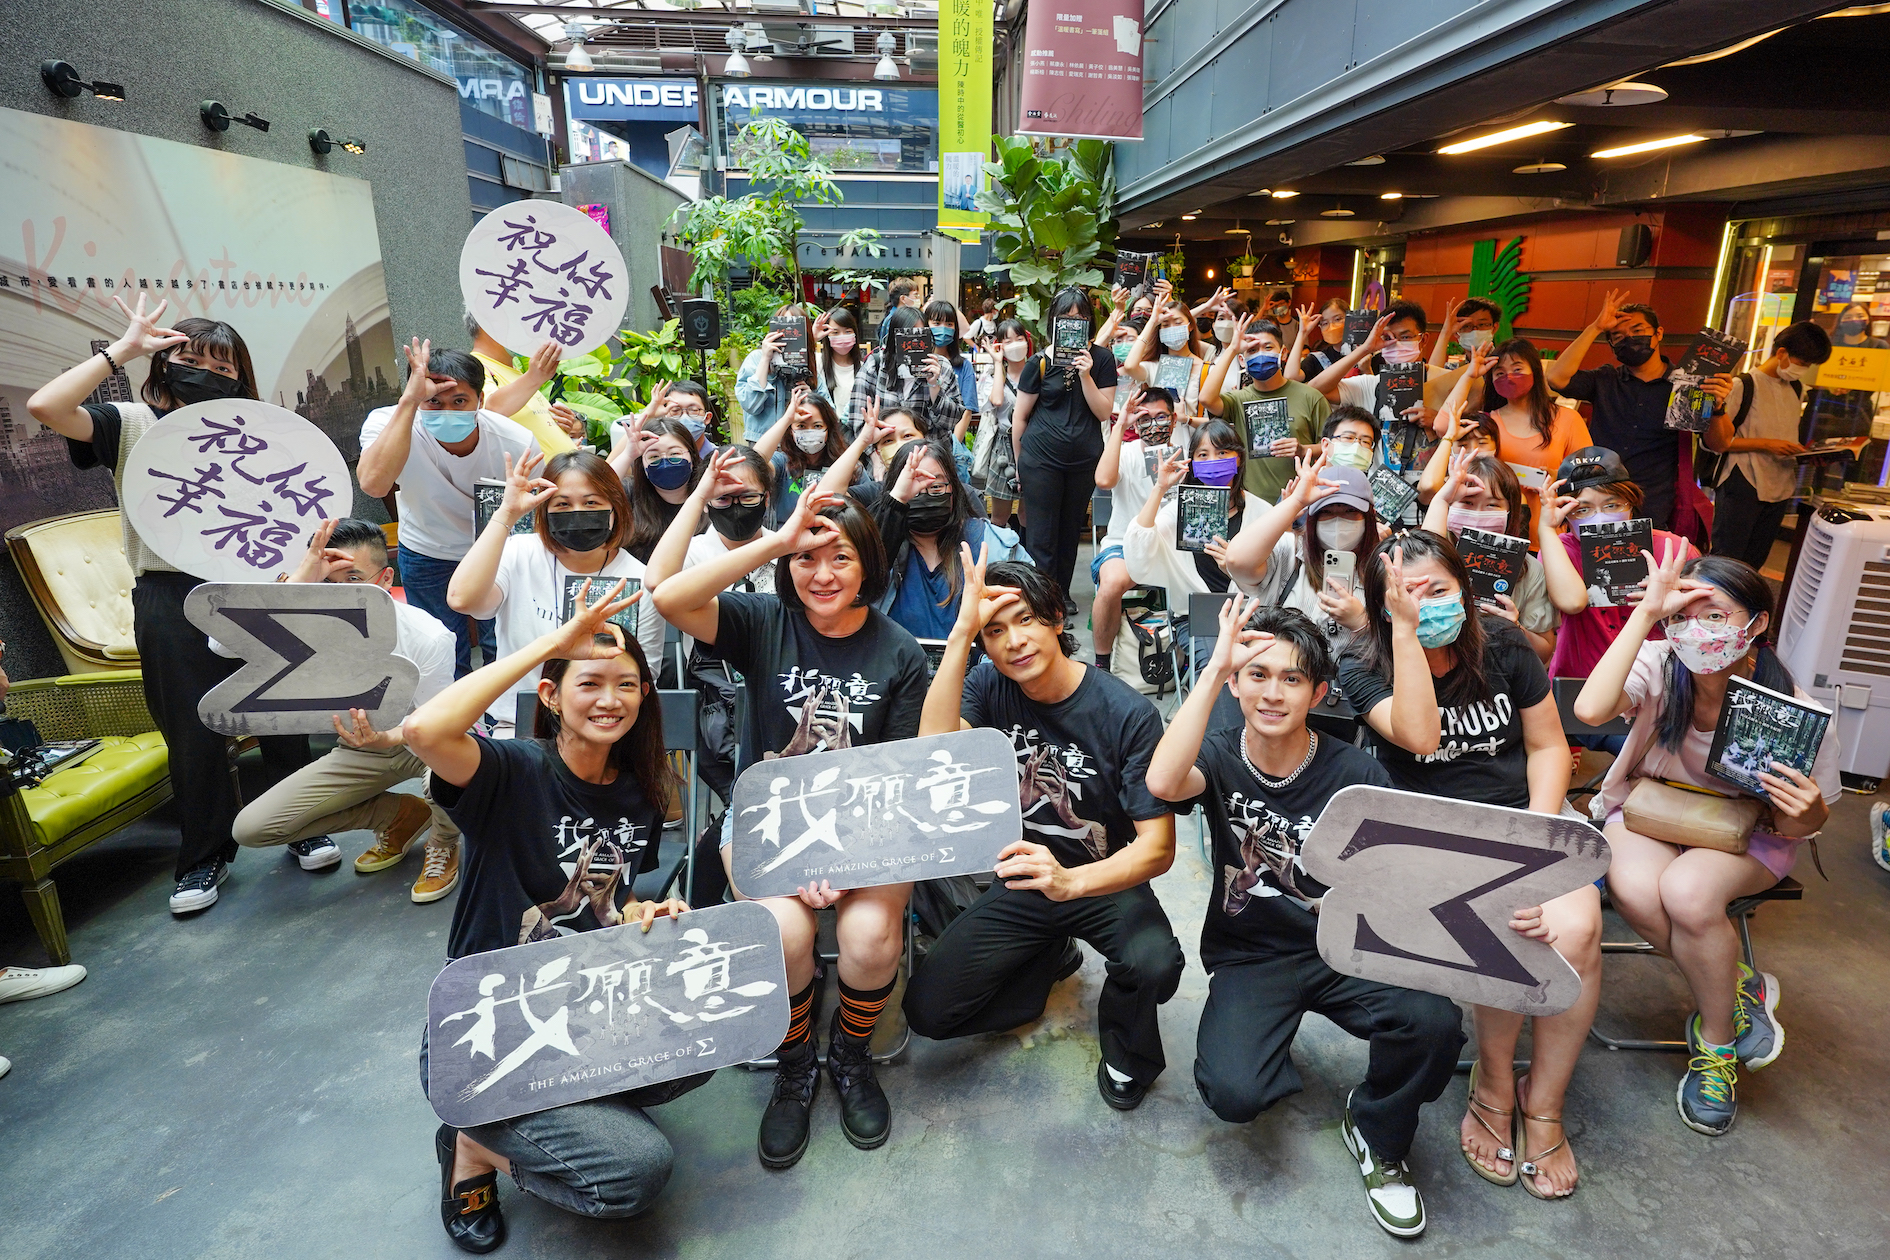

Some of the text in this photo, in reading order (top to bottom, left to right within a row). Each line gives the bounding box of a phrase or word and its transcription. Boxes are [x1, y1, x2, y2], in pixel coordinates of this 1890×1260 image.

[724, 86, 883, 111] ARMOUR
[21, 215, 317, 324] Kingstone
[1570, 456, 1602, 466] TOKYO
[740, 749, 1012, 880] 我願意
[804, 868, 824, 877] THE
[828, 860, 877, 874] AMAZING
[882, 855, 916, 867] GRACE
[921, 853, 935, 861] OF
[439, 928, 778, 1103] 我願意
[528, 1079, 555, 1092] THE
[560, 1062, 622, 1085] AMAZING
[628, 1051, 670, 1068] GRACE
[675, 1046, 692, 1058] OF
